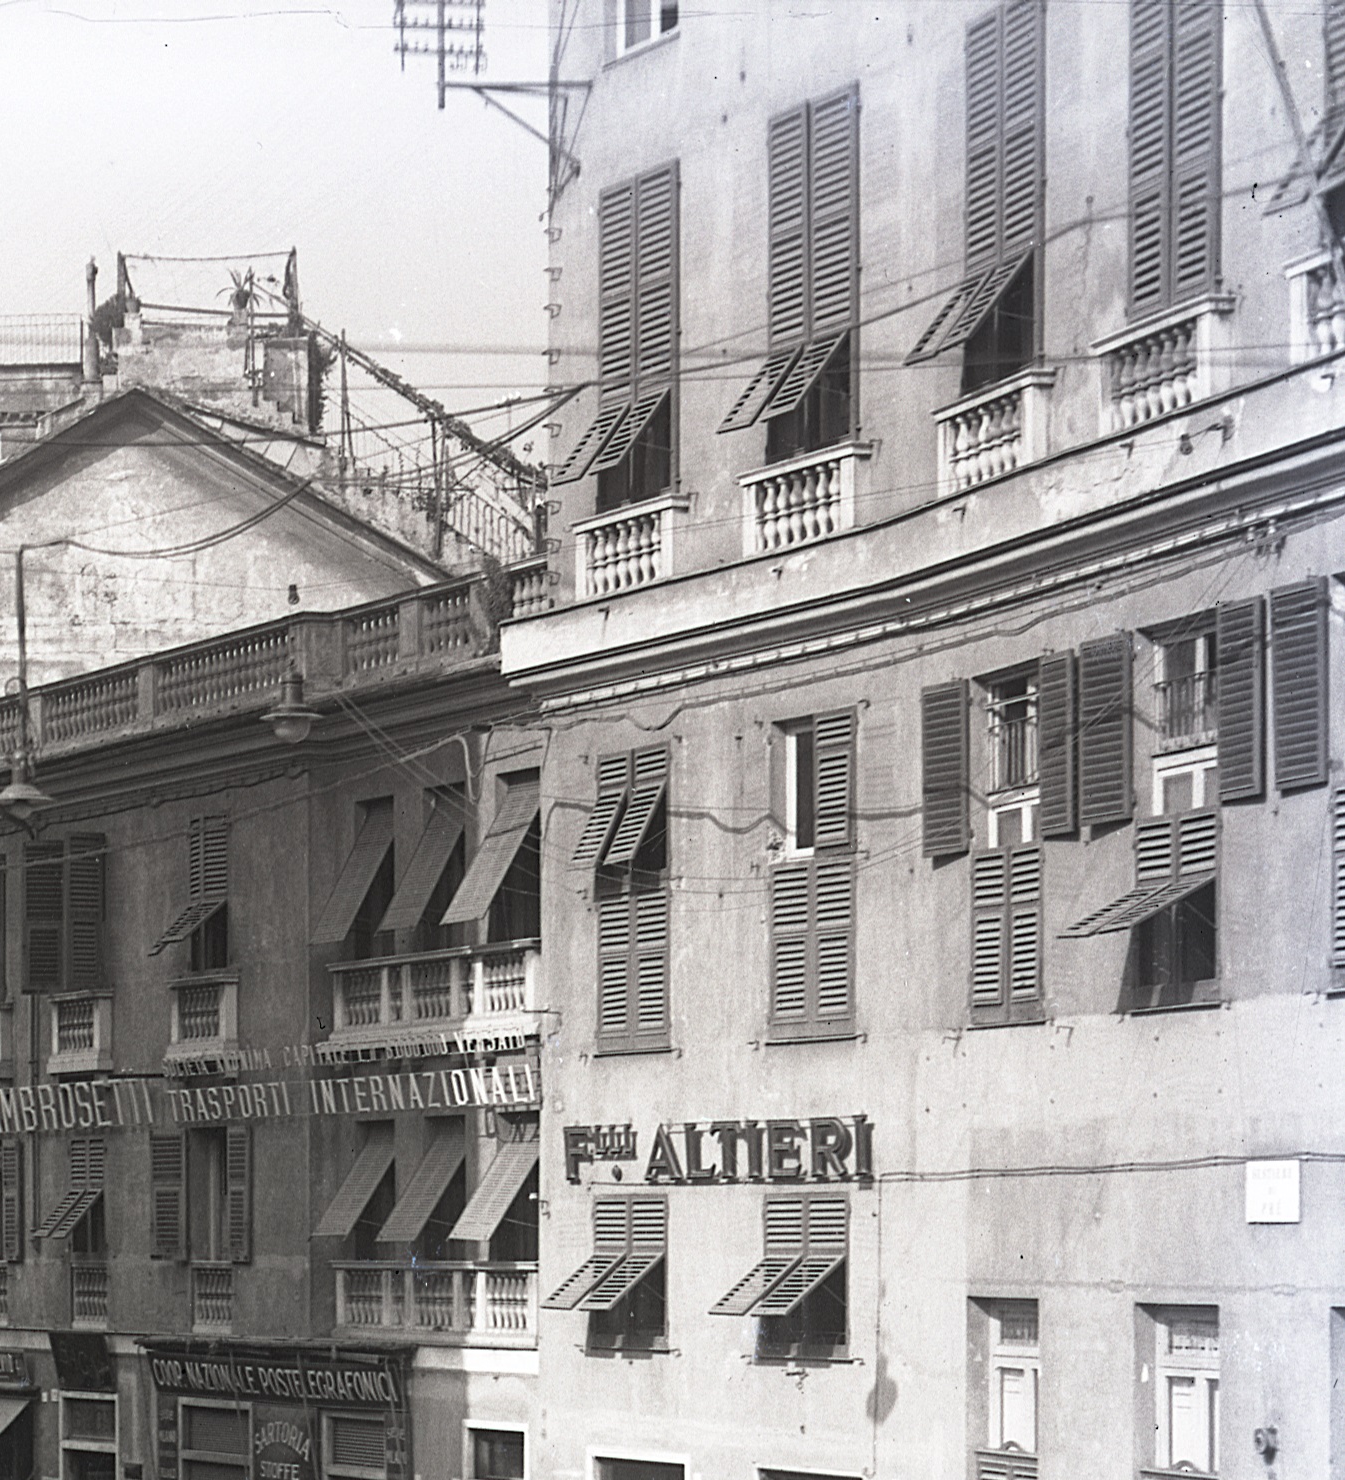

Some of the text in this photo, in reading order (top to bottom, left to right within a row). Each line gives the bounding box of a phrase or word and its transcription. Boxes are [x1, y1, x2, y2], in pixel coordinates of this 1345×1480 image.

[167, 1080, 291, 1122] TRASPORTI
[311, 1063, 537, 1115] INTERNAZIONALI
[645, 1114, 875, 1185] ALTIERI
[185, 1361, 260, 1395] NAZIONALE
[258, 1366, 399, 1403] POSTELEGRAFONICI
[255, 1420, 311, 1462] SARTORIA
